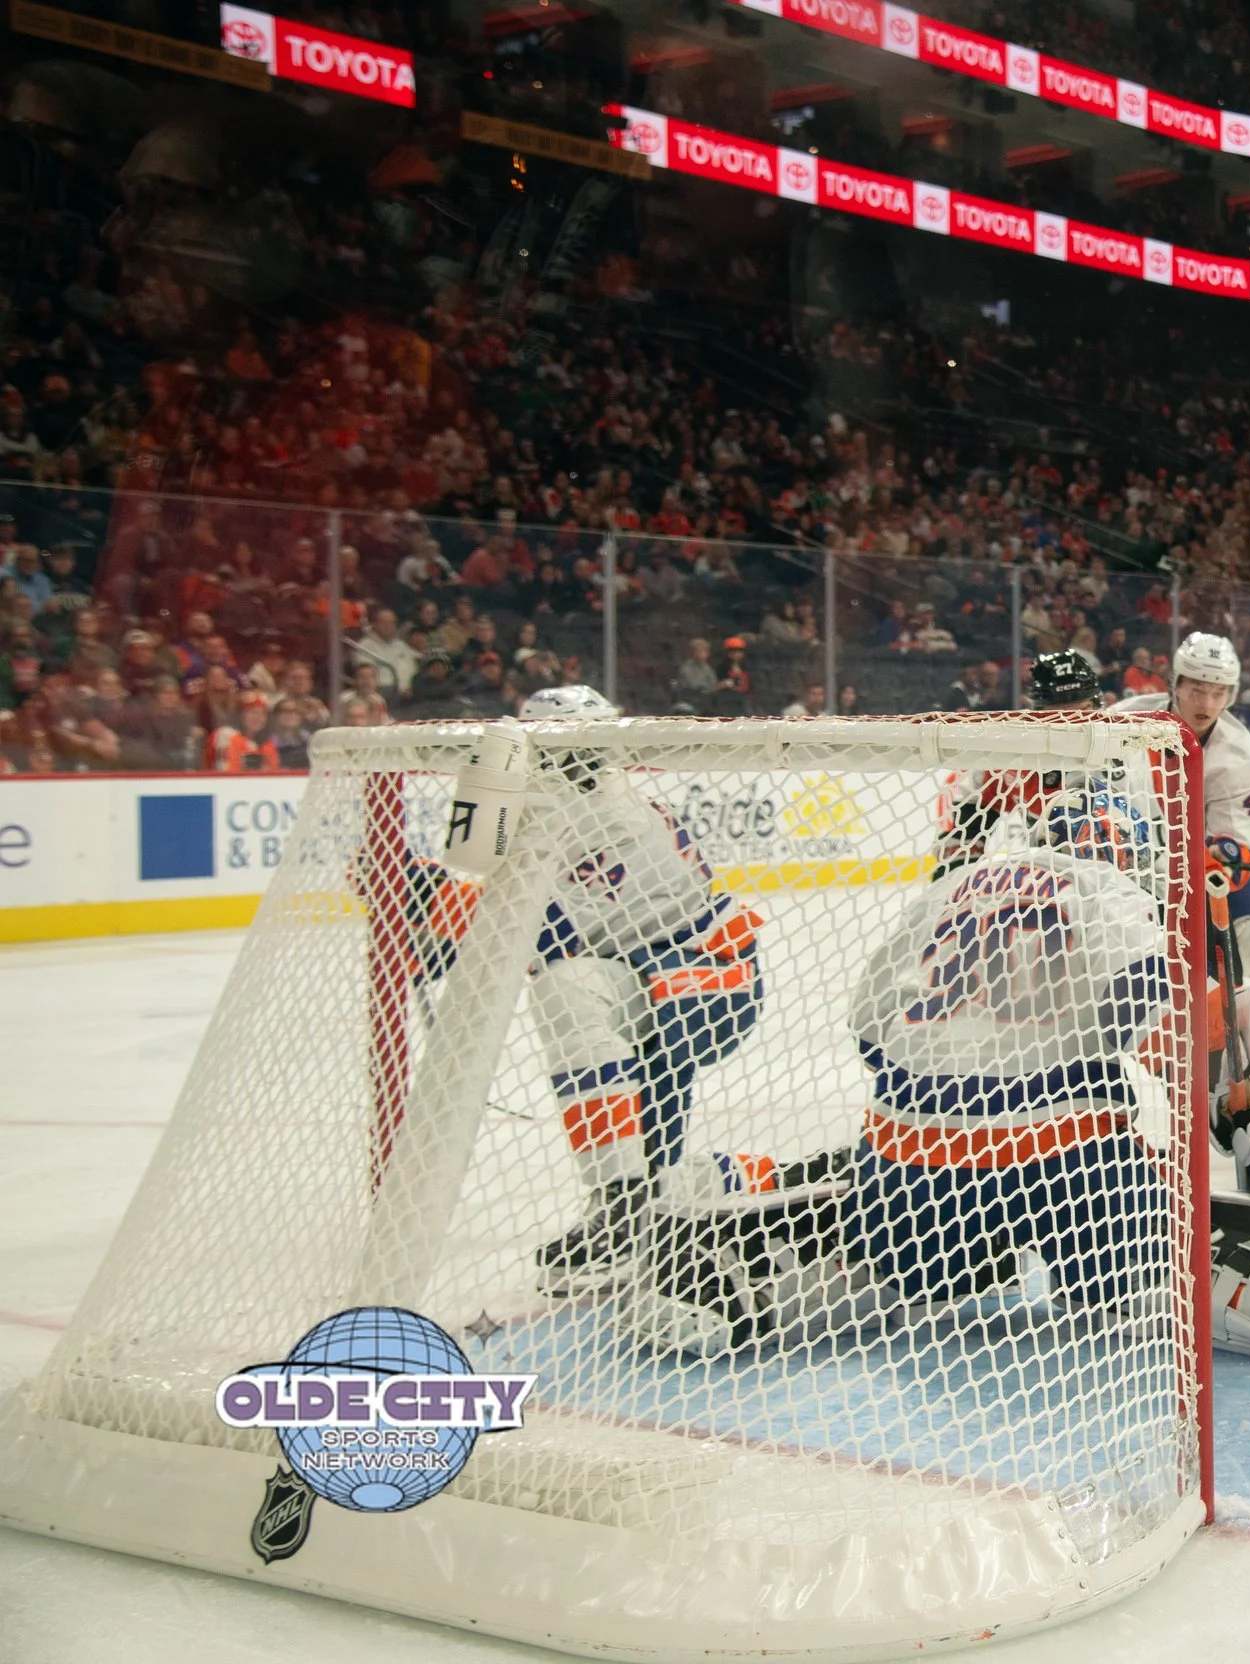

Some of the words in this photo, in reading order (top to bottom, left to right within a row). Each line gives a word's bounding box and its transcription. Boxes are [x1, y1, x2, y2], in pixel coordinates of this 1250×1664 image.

[287, 37, 415, 90] TOYOTA
[924, 28, 1002, 73] TOYOTA
[1044, 67, 1113, 107] TOYOTA
[1151, 101, 1216, 139] TOYOTA
[676, 134, 771, 180] TOYOTA
[824, 172, 910, 212] TOYOTA
[955, 203, 1030, 241] TOYOTA
[1072, 232, 1139, 266] TOYOTA
[1177, 257, 1246, 289] TOYOTA
[1054, 662, 1073, 677] 27
[495, 807, 508, 857] BODYARMOR
[261, 1496, 302, 1537] NHL
